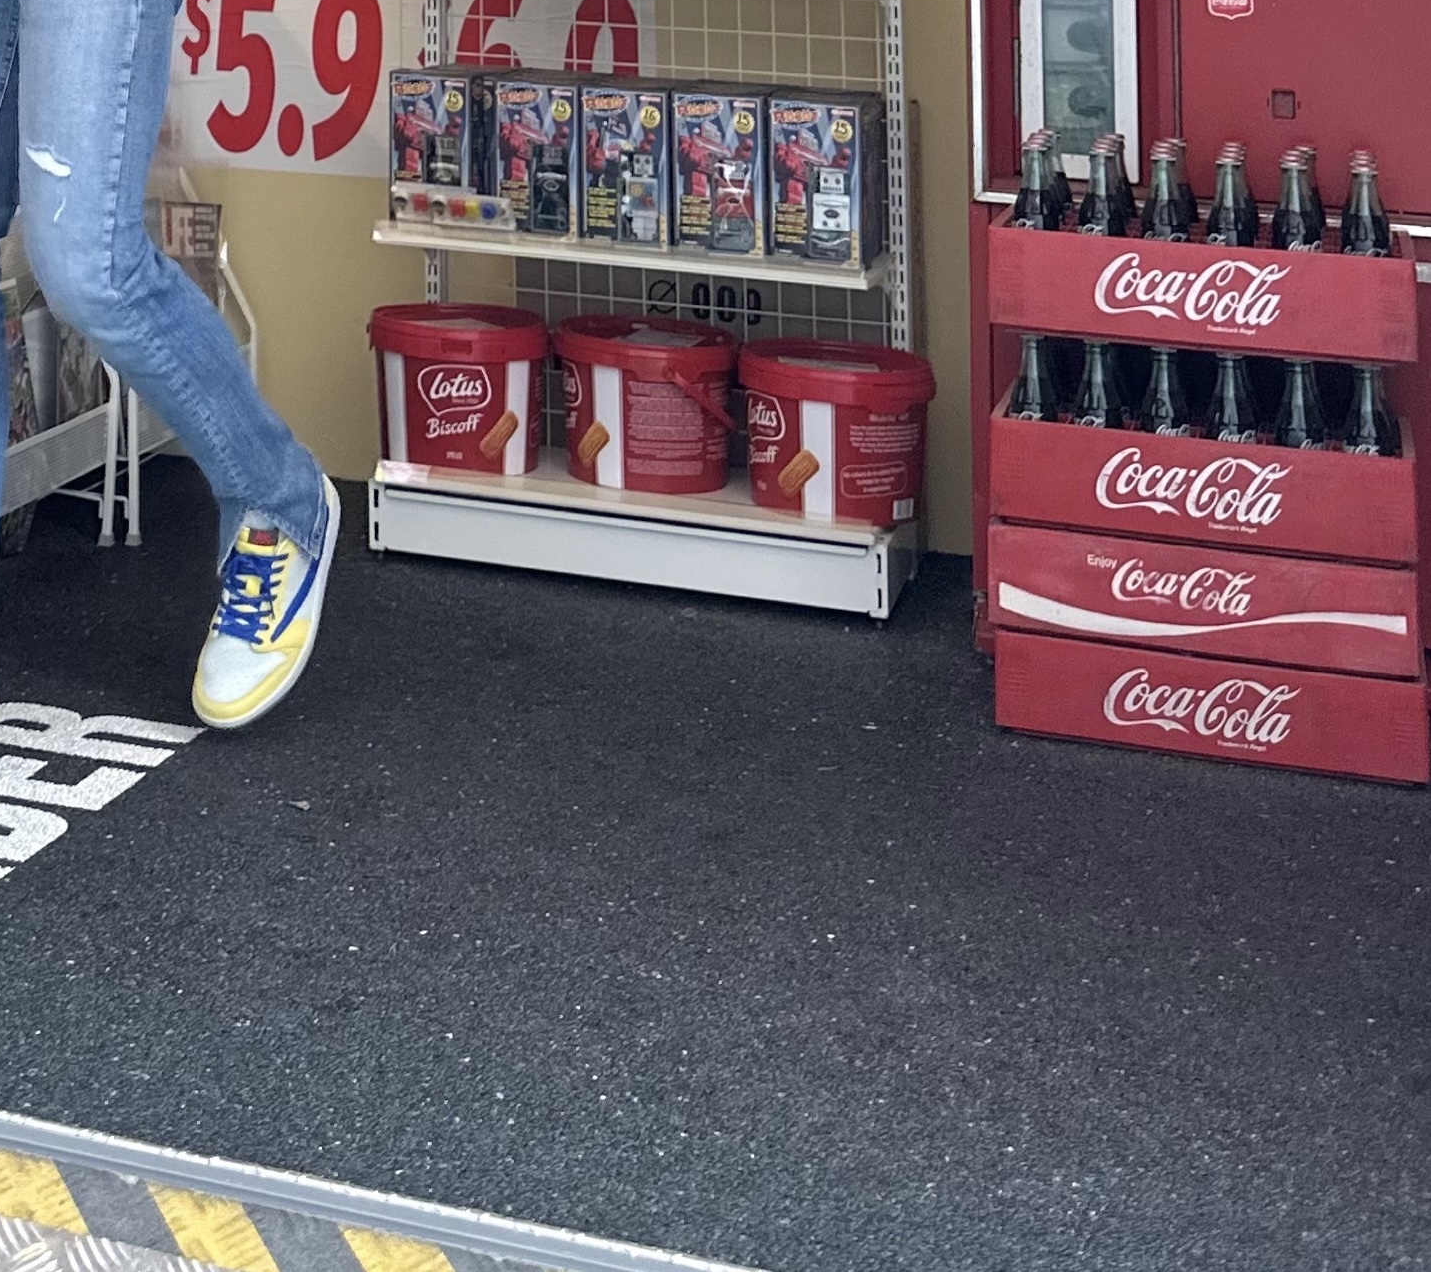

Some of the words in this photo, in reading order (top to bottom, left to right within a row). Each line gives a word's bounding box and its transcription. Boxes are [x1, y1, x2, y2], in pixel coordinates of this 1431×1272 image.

[1093, 252, 1293, 326] Coca-Cola
[428, 371, 485, 400] Lotus
[425, 413, 485, 439] Biscoff
[1095, 447, 1295, 527] Coca-Cola
[1086, 553, 1119, 570] Enjoy
[1111, 558, 1257, 616] Coca-Cola
[1103, 667, 1302, 745] Coca-Cola
